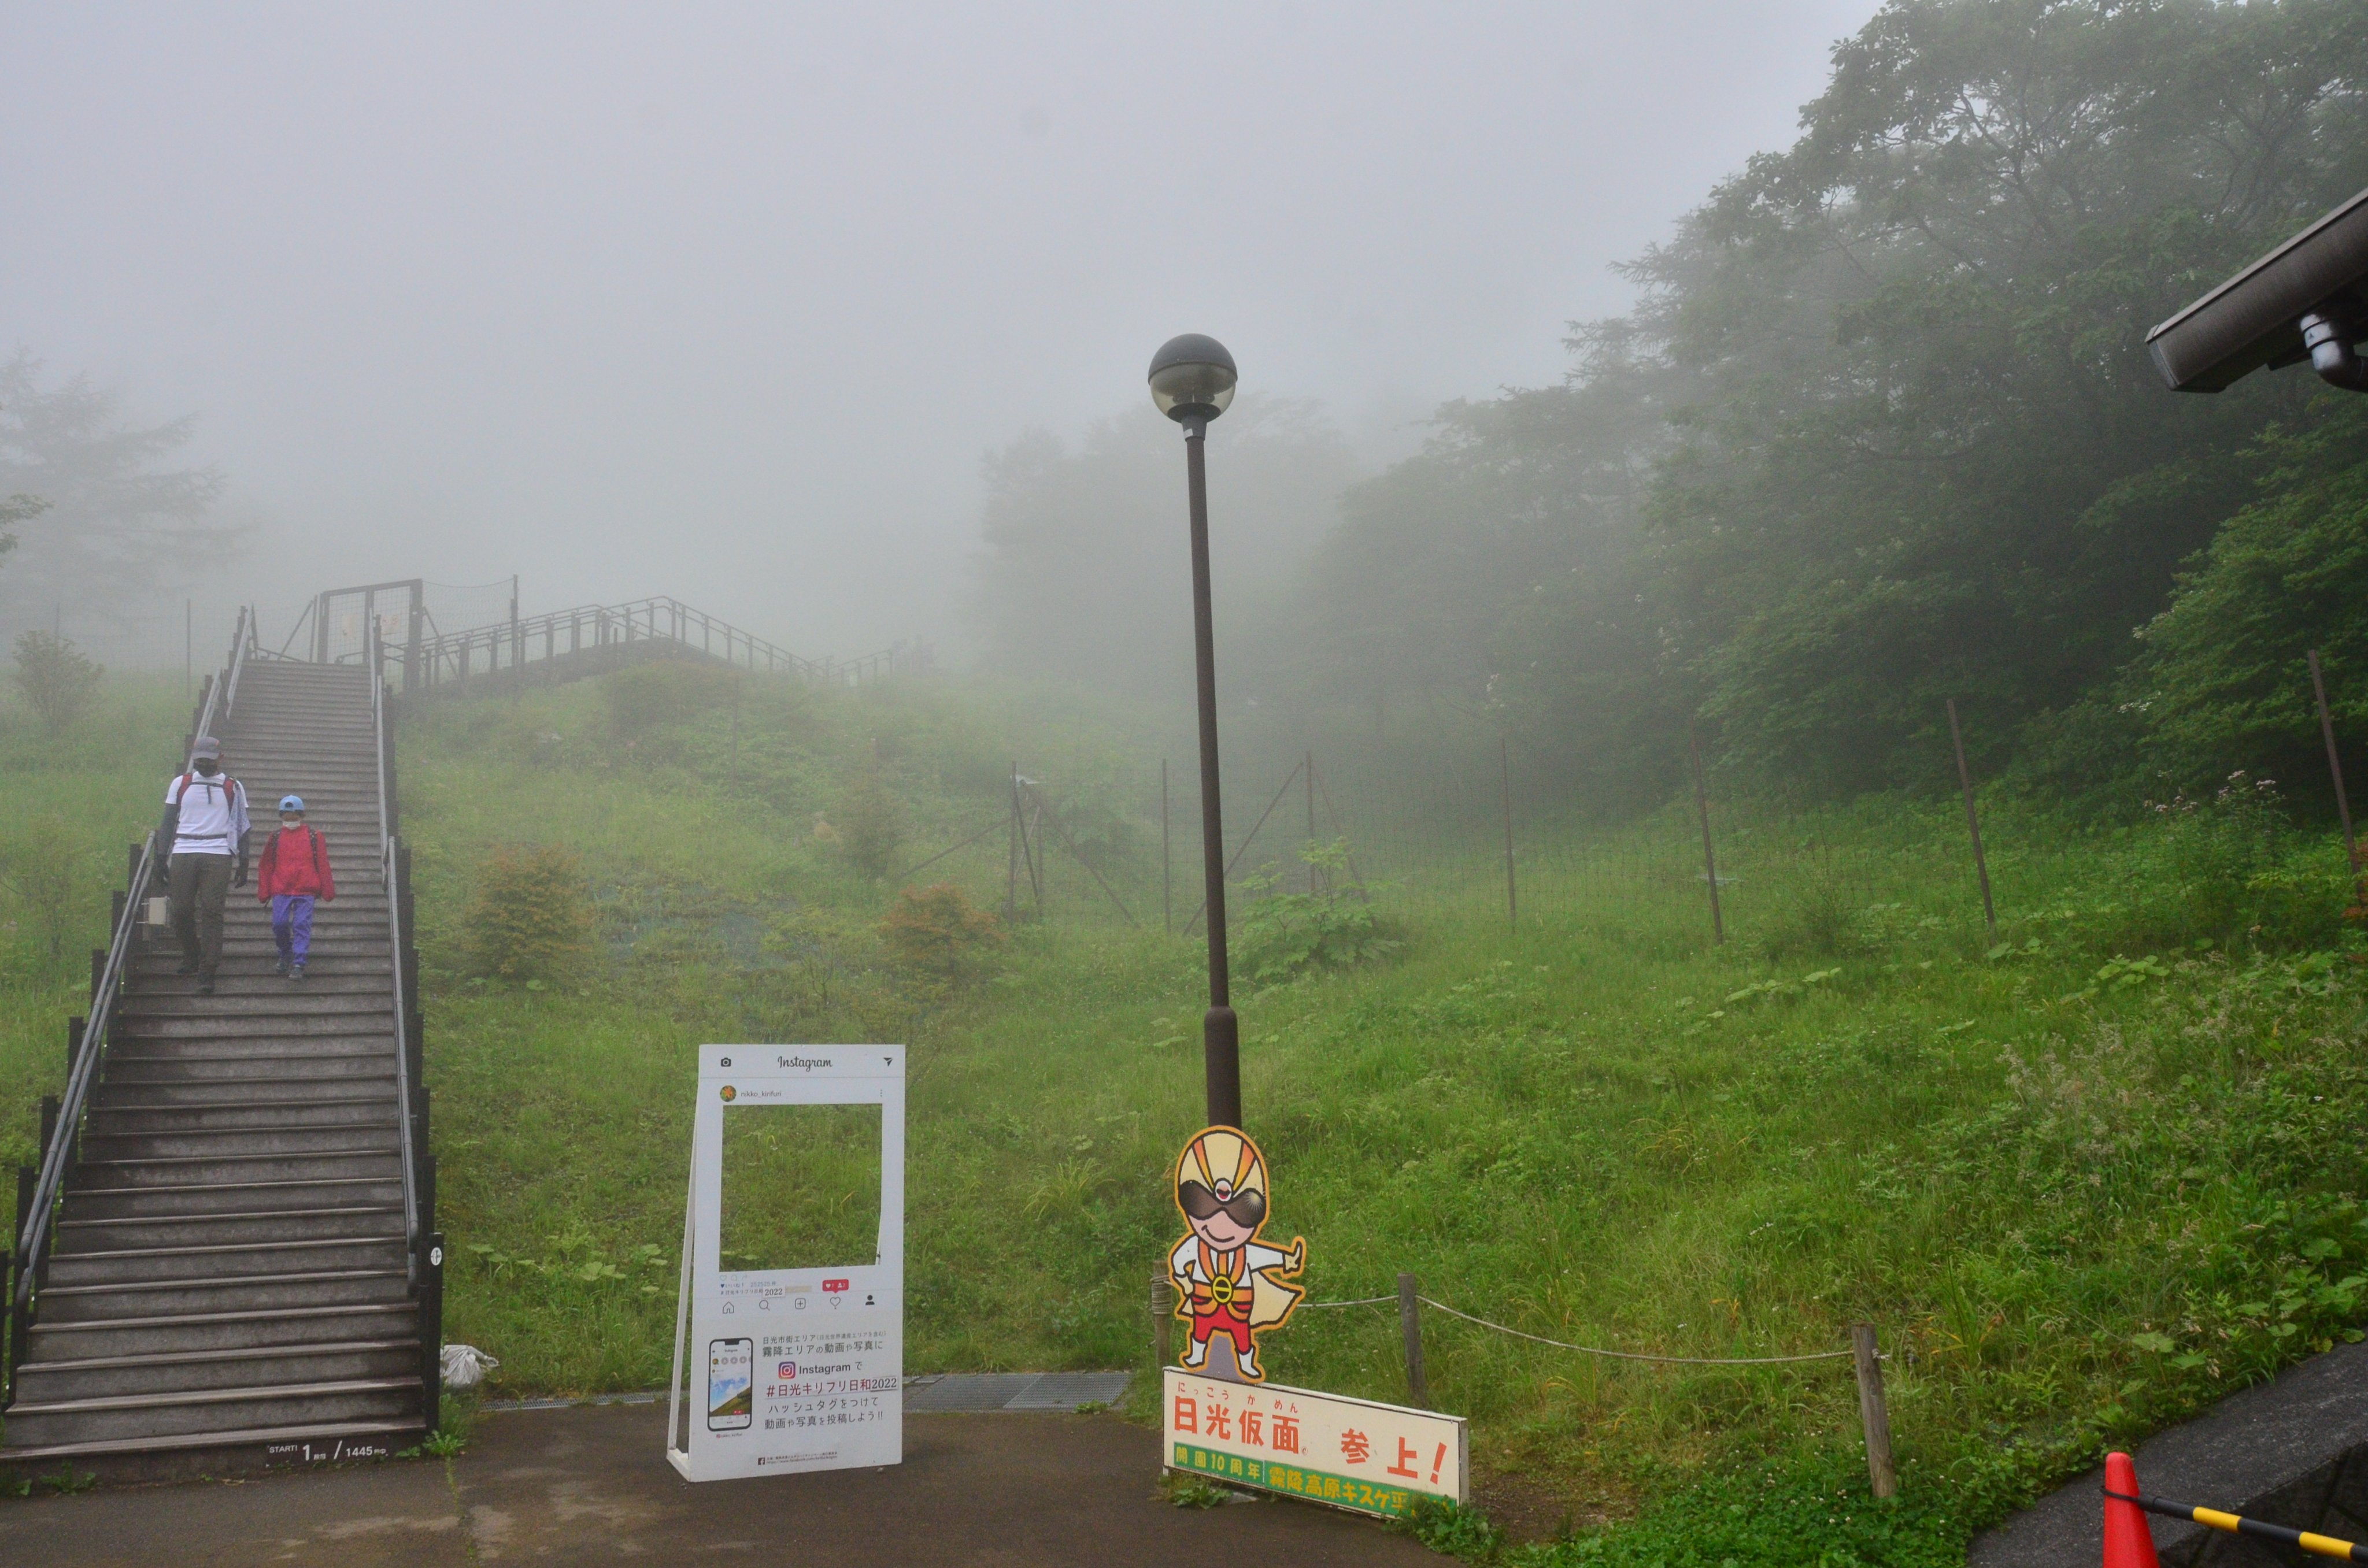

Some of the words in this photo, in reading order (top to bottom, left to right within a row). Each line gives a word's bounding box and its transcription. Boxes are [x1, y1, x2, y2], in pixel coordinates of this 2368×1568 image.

[777, 1055, 832, 1072] Instagram
[799, 1363, 851, 1375] Instagram
[768, 1397, 879, 1414] ハッシュタグをつけて
[1174, 1395, 1300, 1454] 日光仮面
[269, 1445, 298, 1454] START!
